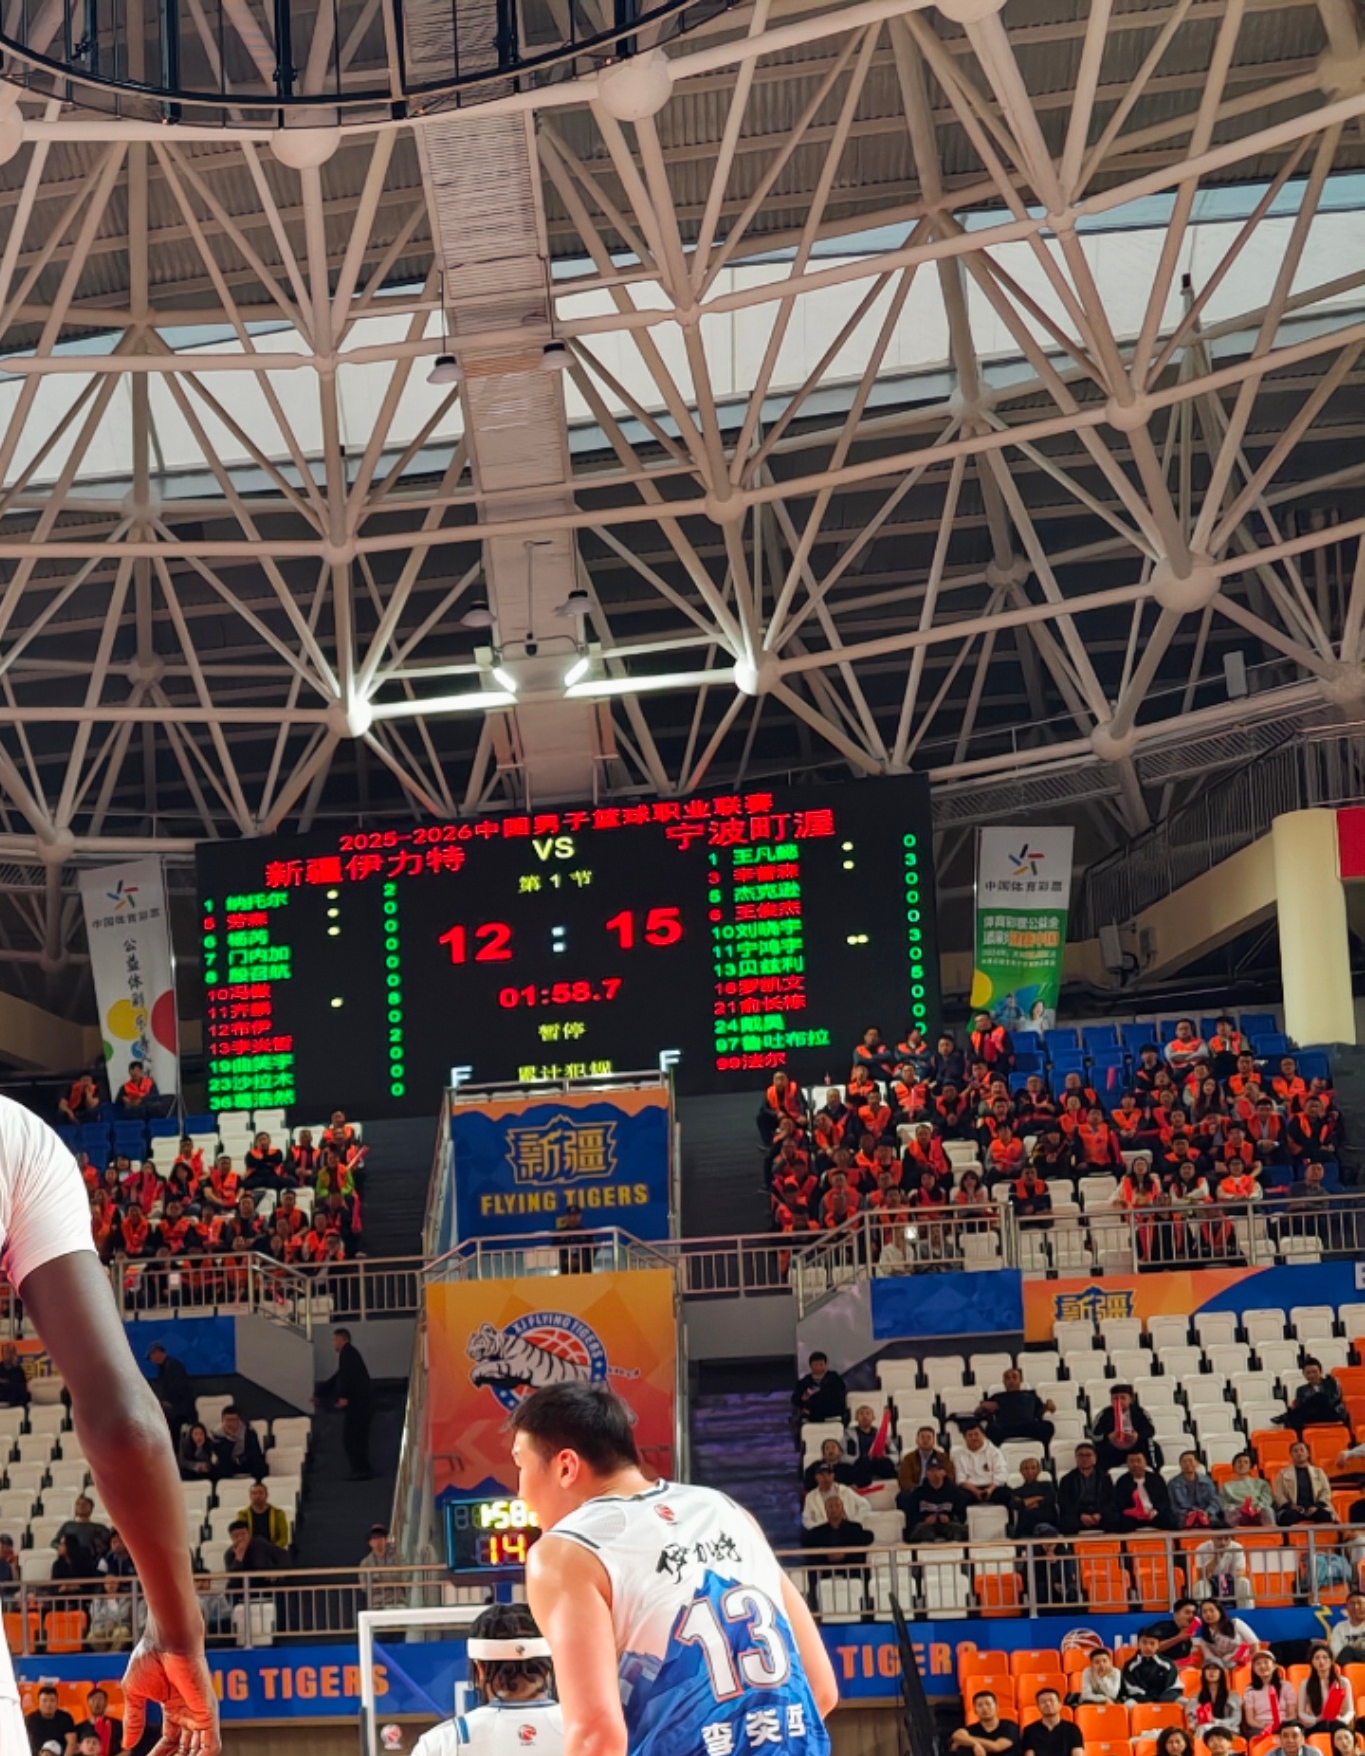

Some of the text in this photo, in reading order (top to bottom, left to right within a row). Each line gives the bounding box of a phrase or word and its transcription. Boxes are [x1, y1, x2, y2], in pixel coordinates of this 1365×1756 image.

[666, 808, 836, 850] 宁波町渥
[532, 836, 576, 861] VS
[708, 853, 718, 866] 1
[265, 845, 465, 888] 新疆伊力特
[204, 899, 214, 912] 1
[438, 922, 513, 964] 12
[605, 907, 684, 950] 15
[204, 953, 217, 966] 7
[498, 977, 623, 1009] 01:58.7
[450, 1065, 473, 1088] F
[658, 1049, 682, 1073] F
[518, 1128, 607, 1179] 新疆
[480, 1183, 650, 1216] FLYING TIGERS
[528, 1313, 570, 1330] FLYING
[569, 1316, 605, 1359] TIGERS
[490, 1534, 526, 1566] 14
[675, 1584, 791, 1703] 13
[836, 1641, 978, 1680] TIGER
[259, 1665, 390, 1700] TIGERS
